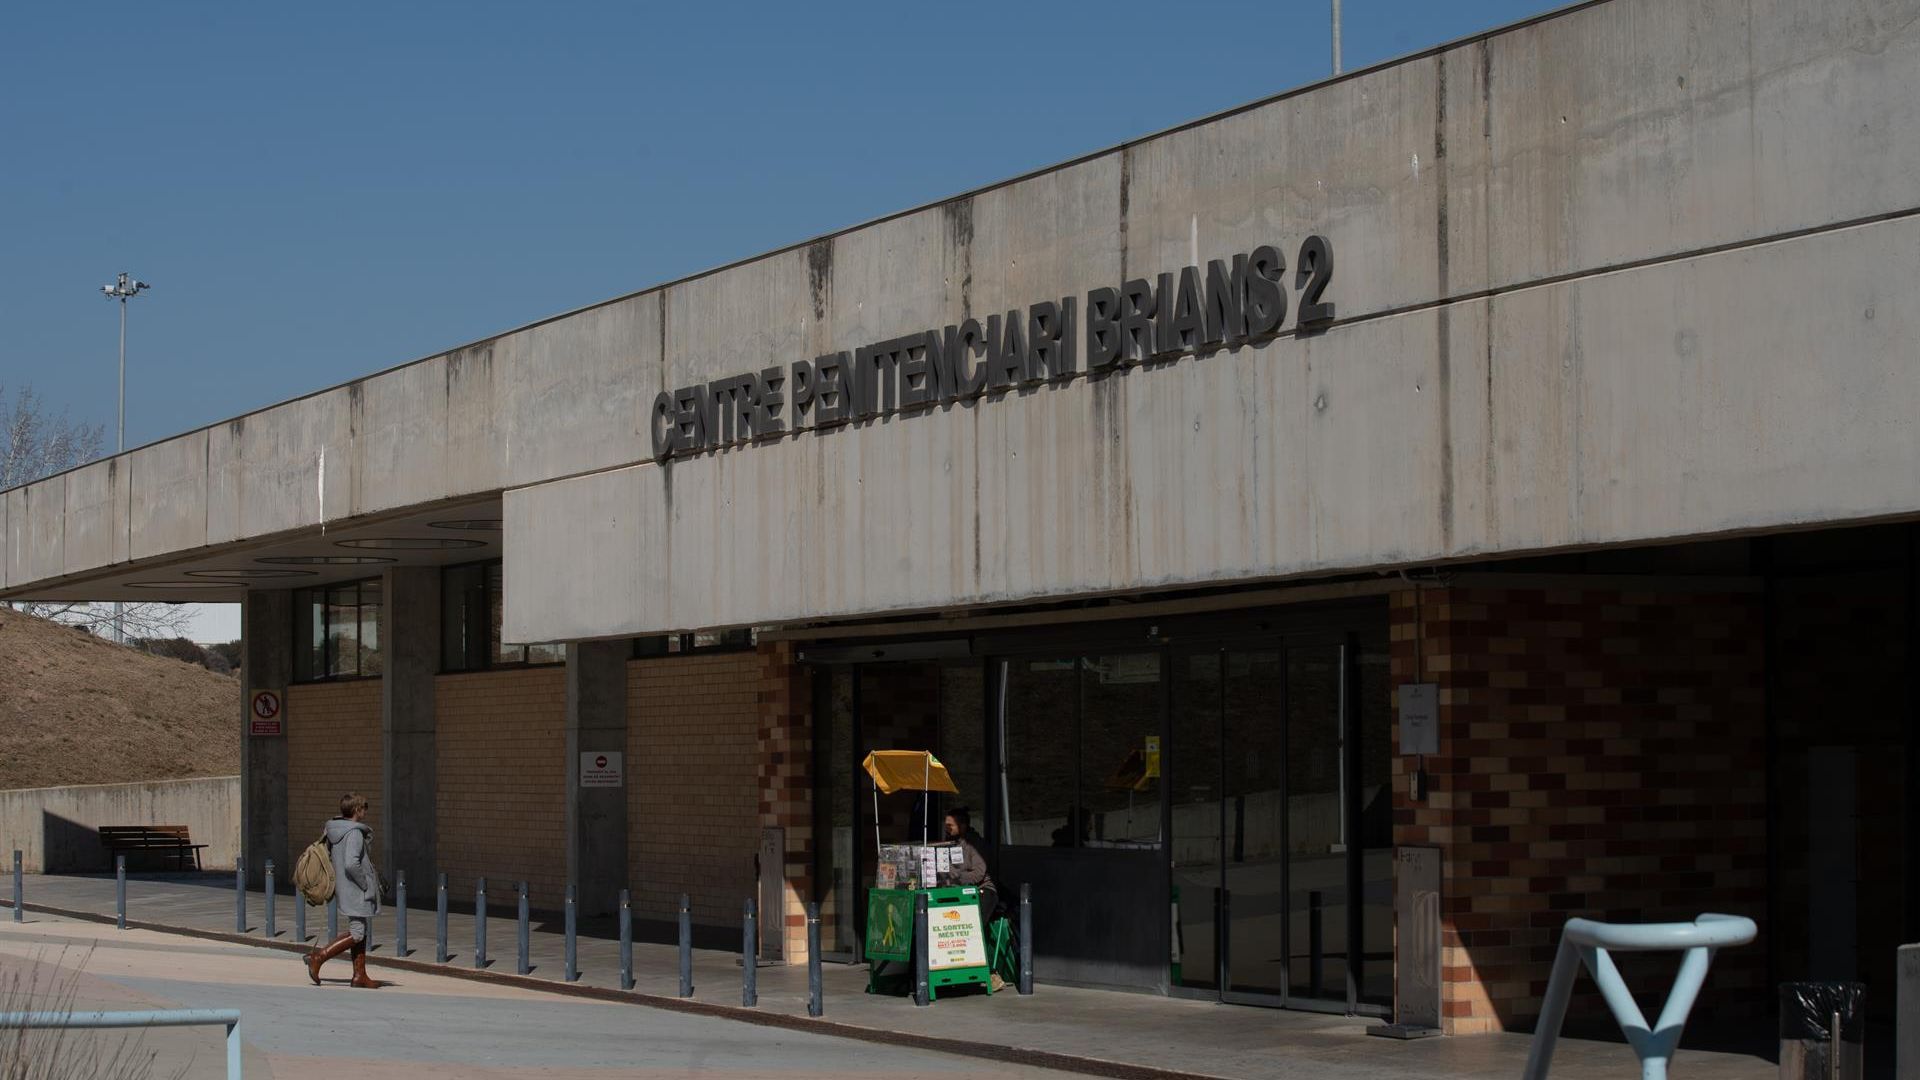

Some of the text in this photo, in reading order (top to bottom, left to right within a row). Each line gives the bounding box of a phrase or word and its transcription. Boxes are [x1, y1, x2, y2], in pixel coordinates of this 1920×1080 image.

[651, 235, 1335, 461] CENTRE PENITENCIARI BRIANS 2
